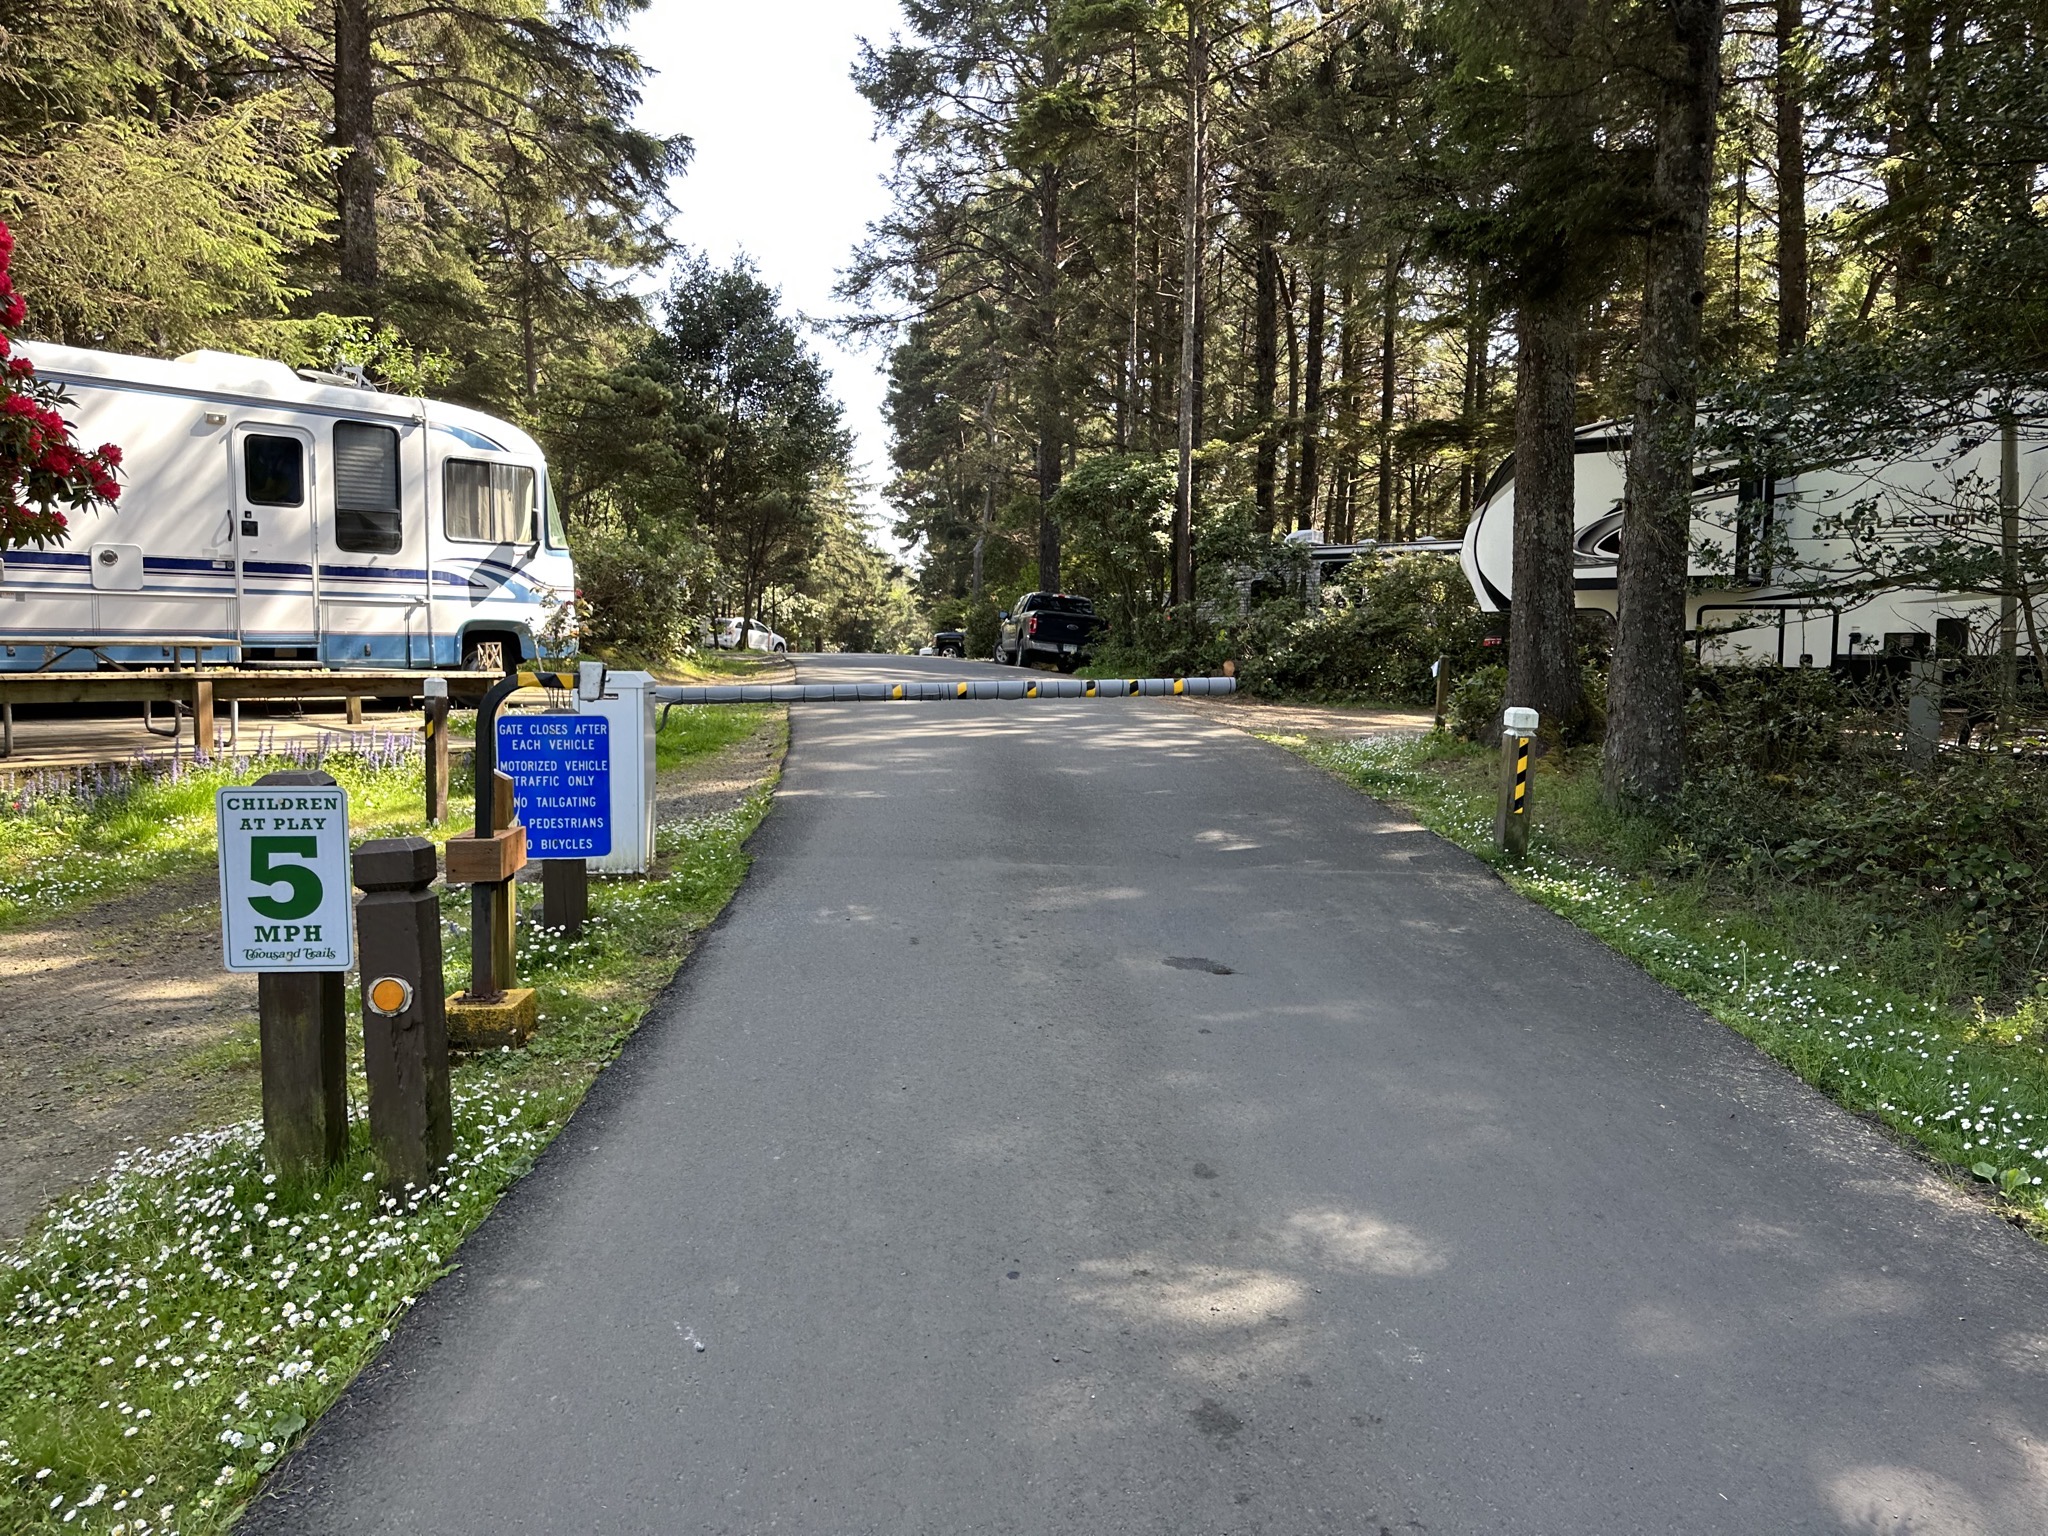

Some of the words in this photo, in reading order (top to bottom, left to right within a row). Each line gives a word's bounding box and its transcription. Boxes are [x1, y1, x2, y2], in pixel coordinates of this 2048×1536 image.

[499, 724, 523, 735] GATE
[530, 724, 568, 735] CLOSES
[575, 724, 607, 735] AFTER
[512, 739, 541, 750] EACH
[549, 739, 595, 750] VEHICLE
[500, 761, 557, 771] MOTORIZED
[565, 760, 608, 771] VEHICLE
[514, 776, 560, 786] TRAFFIC
[568, 776, 595, 786] ONLY
[227, 798, 338, 810] CHILDREN
[514, 797, 528, 808] NO
[536, 797, 596, 808] TAILGATING
[240, 818, 265, 830] AT
[273, 818, 327, 830] PLAY
[529, 818, 604, 829] PEDESTRIANS
[541, 839, 593, 850] BICYCLES
[247, 836, 323, 920] 5
[254, 925, 323, 942] MPH
[242, 949, 301, 961] Thousand
[303, 947, 336, 959] Trails
